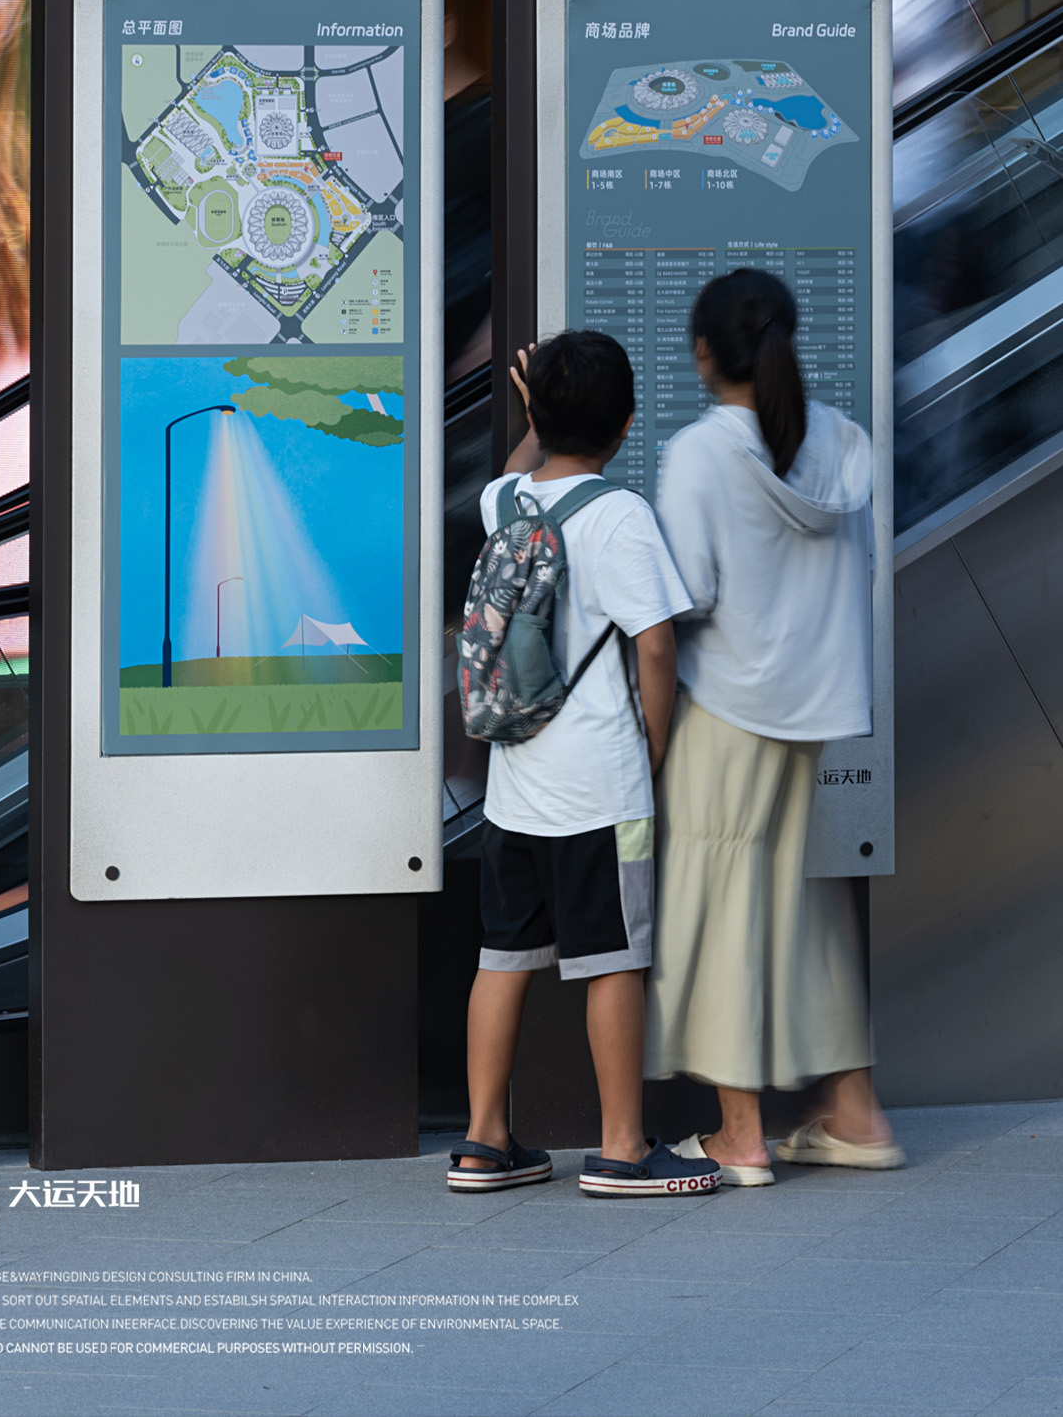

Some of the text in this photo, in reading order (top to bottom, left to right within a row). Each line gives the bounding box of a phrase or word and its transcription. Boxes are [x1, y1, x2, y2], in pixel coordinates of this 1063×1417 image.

[122, 20, 182, 35] 总平面图
[317, 23, 403, 36] Information
[586, 22, 650, 38] 商场品牌
[772, 24, 855, 37] Brand Guide
[592, 170, 622, 178] 商场南区
[650, 170, 680, 178] 商场中区
[707, 169, 738, 179] 商场北区
[592, 181, 613, 189] 1-5栋
[650, 181, 671, 189] 1-7栋
[707, 181, 734, 189] 1-10栋
[603, 220, 652, 238] Guide
[666, 1174, 716, 1192] crocs
